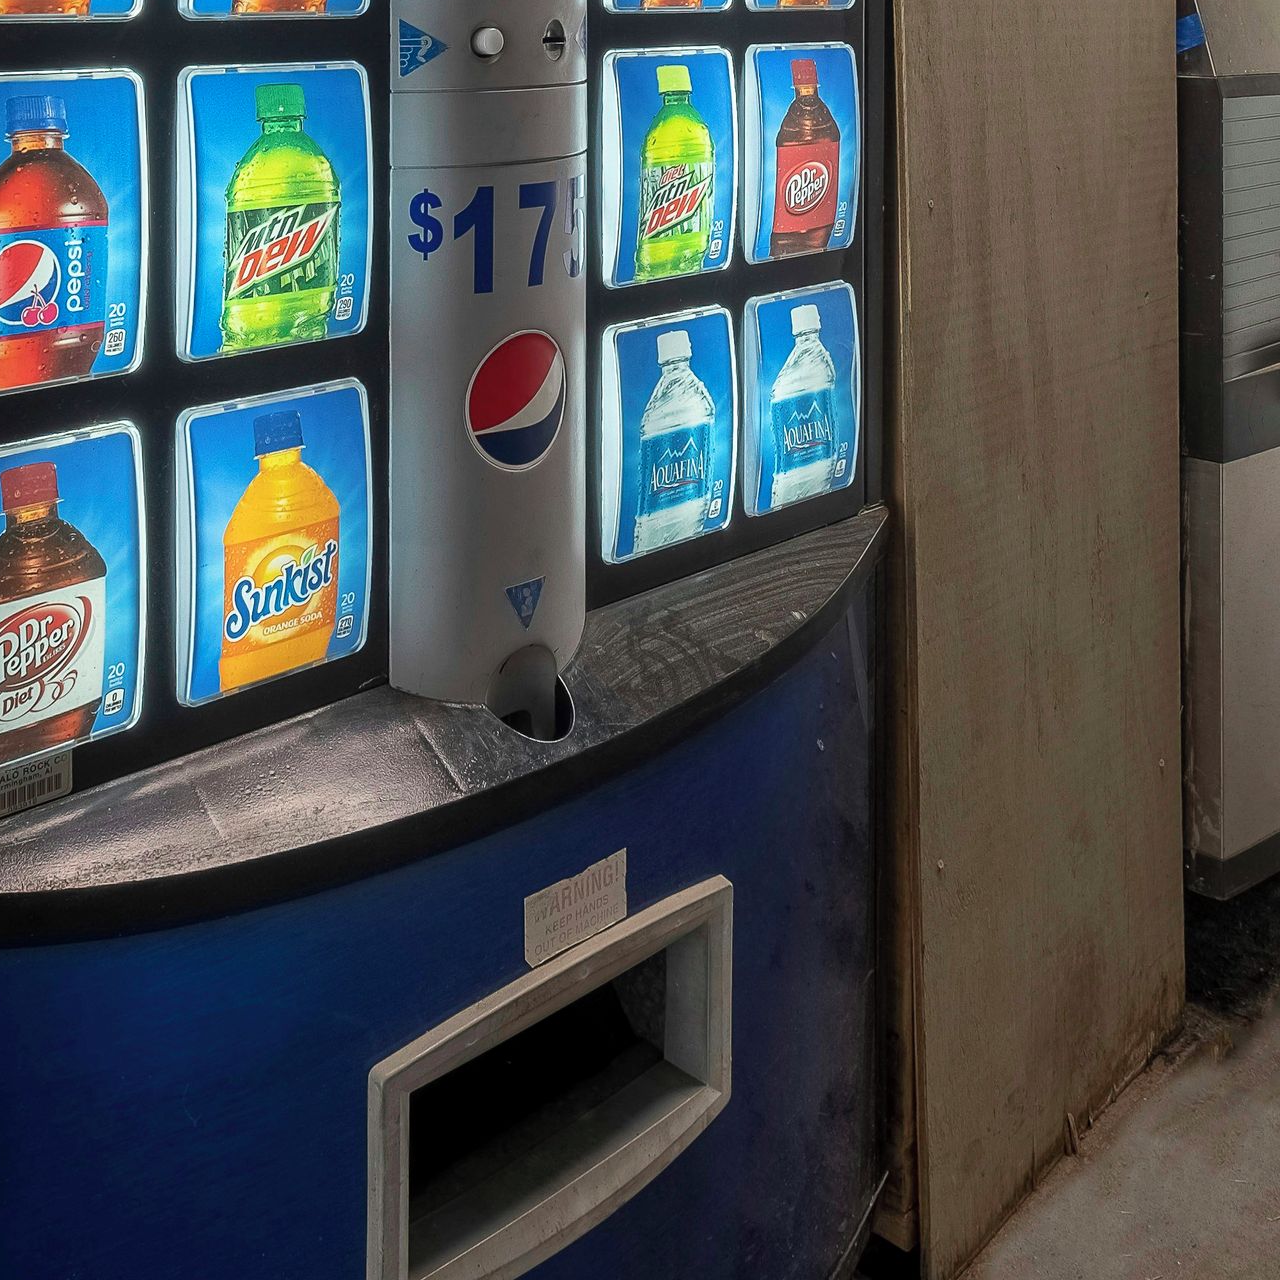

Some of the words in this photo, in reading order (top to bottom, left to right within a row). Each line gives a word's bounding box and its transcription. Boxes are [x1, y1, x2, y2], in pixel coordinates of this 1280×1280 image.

[801, 168, 817, 190] Dr
[790, 173, 826, 209] Pepper
[713, 220, 724, 232] 20
[64, 239, 85, 312] pepsi
[340, 273, 355, 287] 20
[108, 302, 127, 318] 20
[339, 298, 352, 310] 290
[108, 331, 124, 343] 260
[783, 413, 833, 455] AQUAFINA
[839, 441, 849, 452] 20
[648, 449, 705, 495] AQUAFINA
[713, 479, 724, 491] 20
[225, 540, 338, 641] Sunkist
[340, 591, 355, 607] 20
[19, 615, 55, 651] Dr
[263, 617, 299, 635] ORANGE
[299, 611, 323, 625] SODA
[107, 662, 125, 680] 20
[1, 686, 34, 717] Diet
[22, 759, 51, 776] ROCK
[544, 913, 573, 936] KEEP
[575, 894, 609, 918] HANDS
[534, 936, 556, 956] OUT
[558, 927, 573, 943] OF
[575, 903, 619, 934] MACHINE
